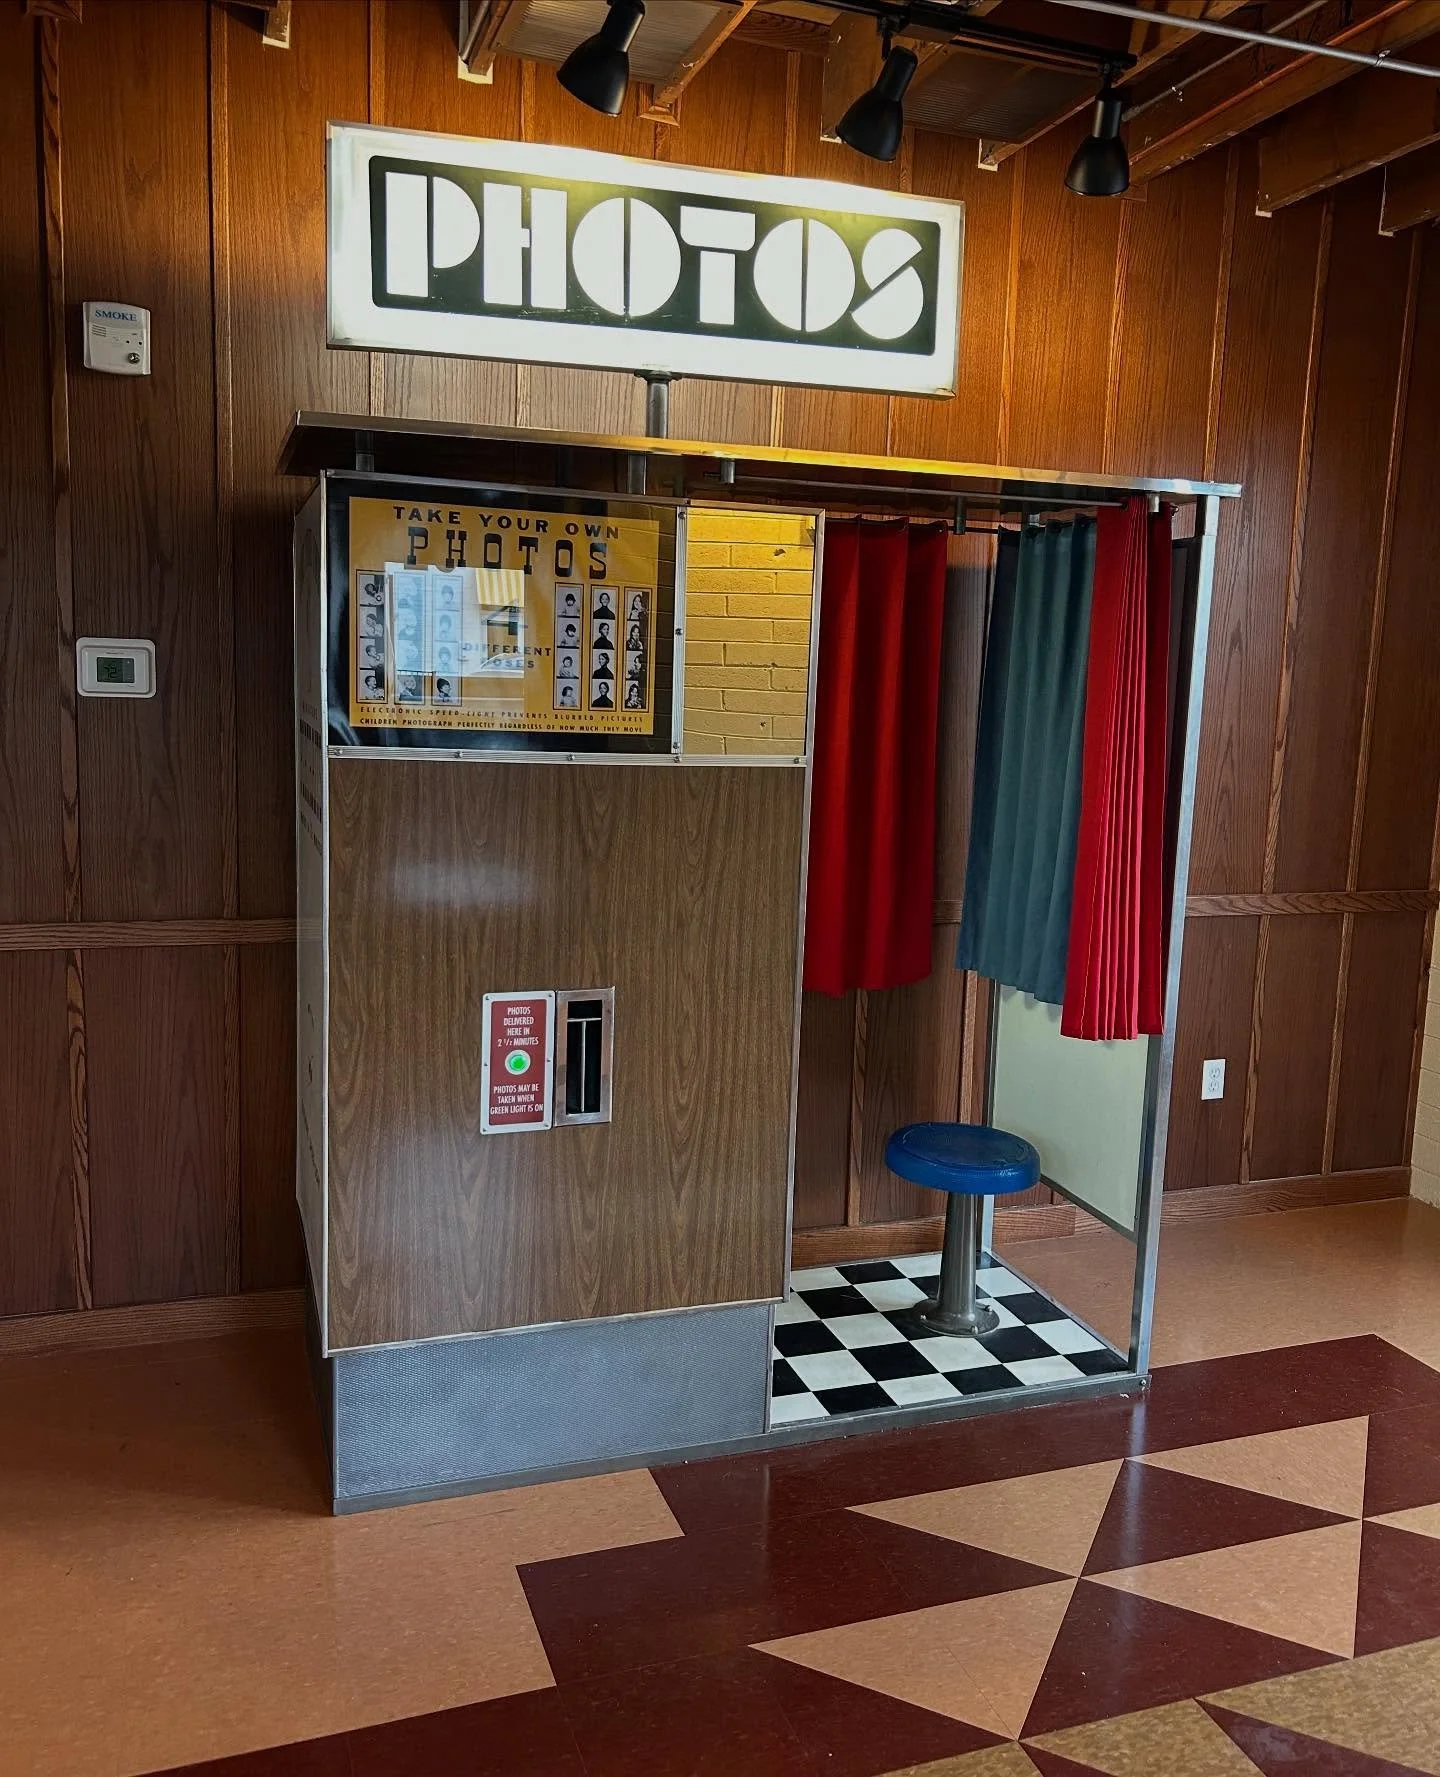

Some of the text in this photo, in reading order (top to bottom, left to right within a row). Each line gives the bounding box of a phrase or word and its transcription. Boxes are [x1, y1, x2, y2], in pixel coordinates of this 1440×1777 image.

[386, 171, 925, 340] PHOTOS
[95, 309, 137, 321] SMOKE
[393, 506, 619, 539] TAKE YOUR OWN
[406, 526, 608, 579] PHOTOS
[464, 643, 551, 656] DIFFERENT
[360, 706, 422, 715] ELECTRONIC
[501, 711, 548, 719] PREVENTS
[402, 719, 453, 727] PHOTOGRAPH
[500, 722, 543, 730] REGARDLESS
[507, 1006, 531, 1015] PHOTOS
[503, 1016, 535, 1026] DELIVERED
[507, 1027, 530, 1036] HERE IN
[497, 1038, 503, 1047] 2
[513, 1036, 539, 1046] MINUTES
[493, 1083, 540, 1094] PHOTOS MAY BE
[497, 1094, 535, 1104] TAKEN WHEN
[490, 1103, 544, 1115] GREEN LIGHT IS ON
